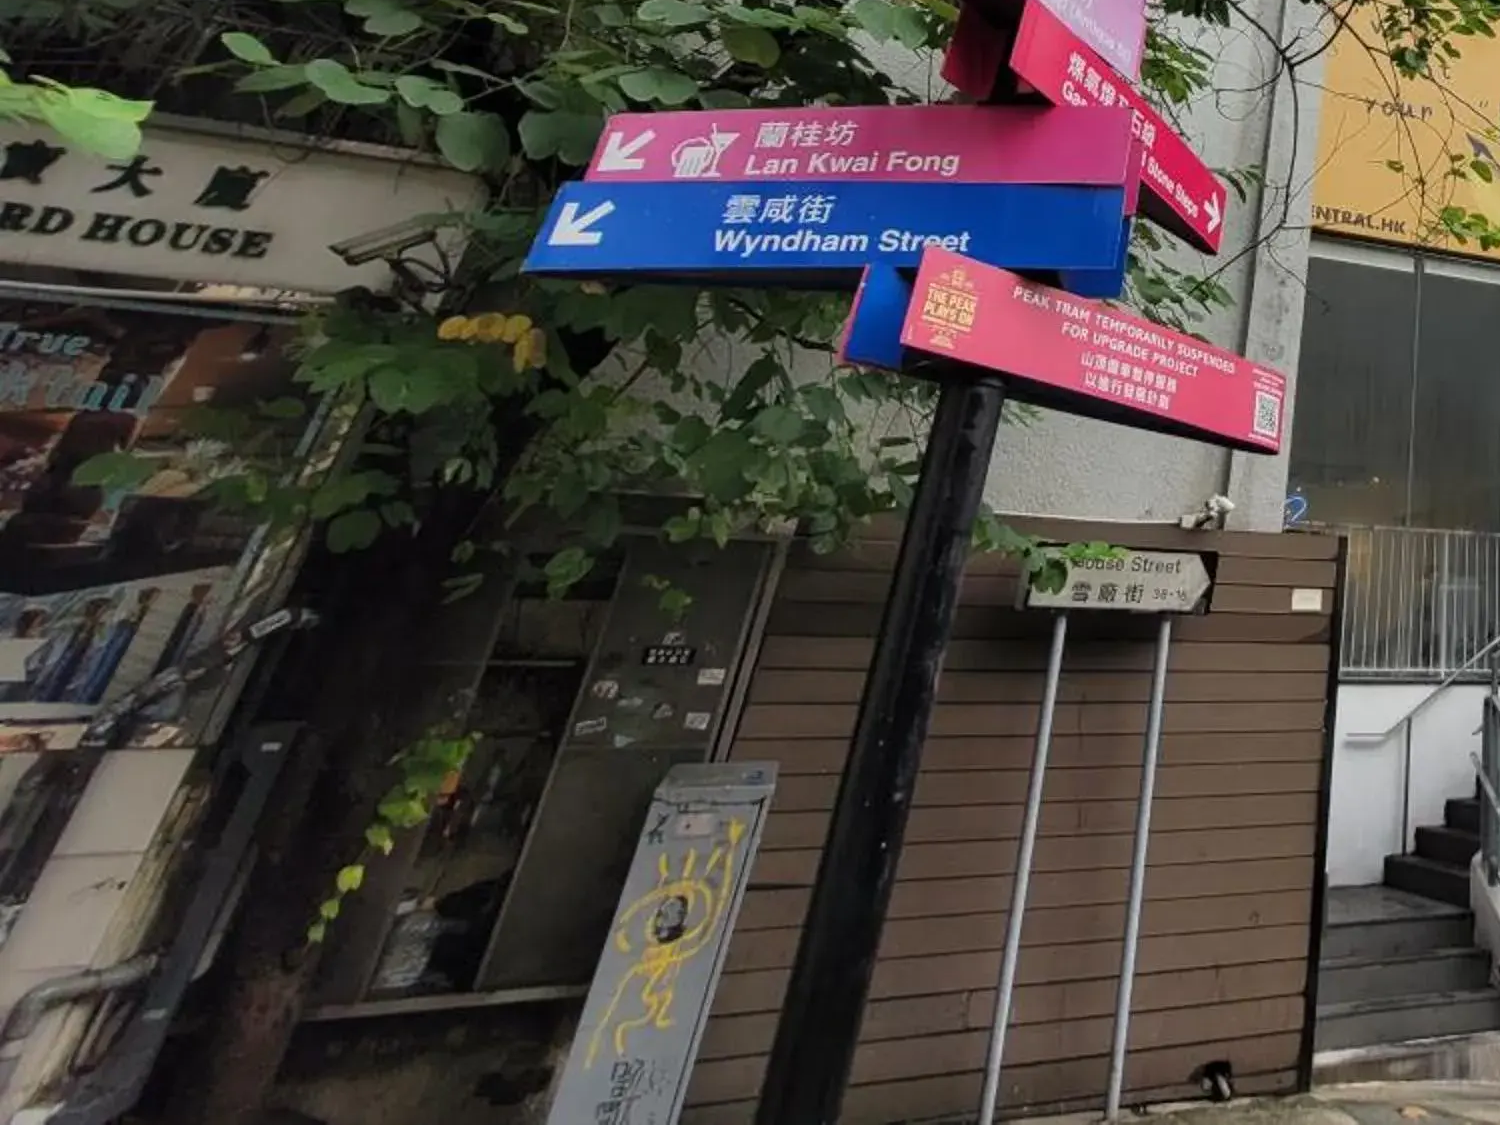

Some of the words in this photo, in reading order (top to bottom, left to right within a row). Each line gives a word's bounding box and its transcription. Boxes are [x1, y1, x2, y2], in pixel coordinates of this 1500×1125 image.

[754, 120, 859, 150] 蘭桂坊
[742, 154, 799, 176] Lan
[807, 150, 879, 174] Kwai
[886, 150, 961, 176] Fong
[721, 194, 838, 225] 雲咸街
[80, 212, 275, 260] HOUSE
[714, 228, 870, 259] Wyndham
[877, 228, 972, 254] Street
[1013, 286, 1051, 309] PEAK
[1054, 300, 1092, 323] TRAM
[1095, 314, 1175, 352] TEMPORARILY
[1177, 344, 1236, 375] SUSPENDED
[1061, 322, 1090, 341] FOR
[1092, 332, 1150, 362] UPGRADE
[1151, 352, 1200, 378] PROJECT
[1072, 555, 1126, 572] ouse
[1131, 554, 1182, 575] Street
